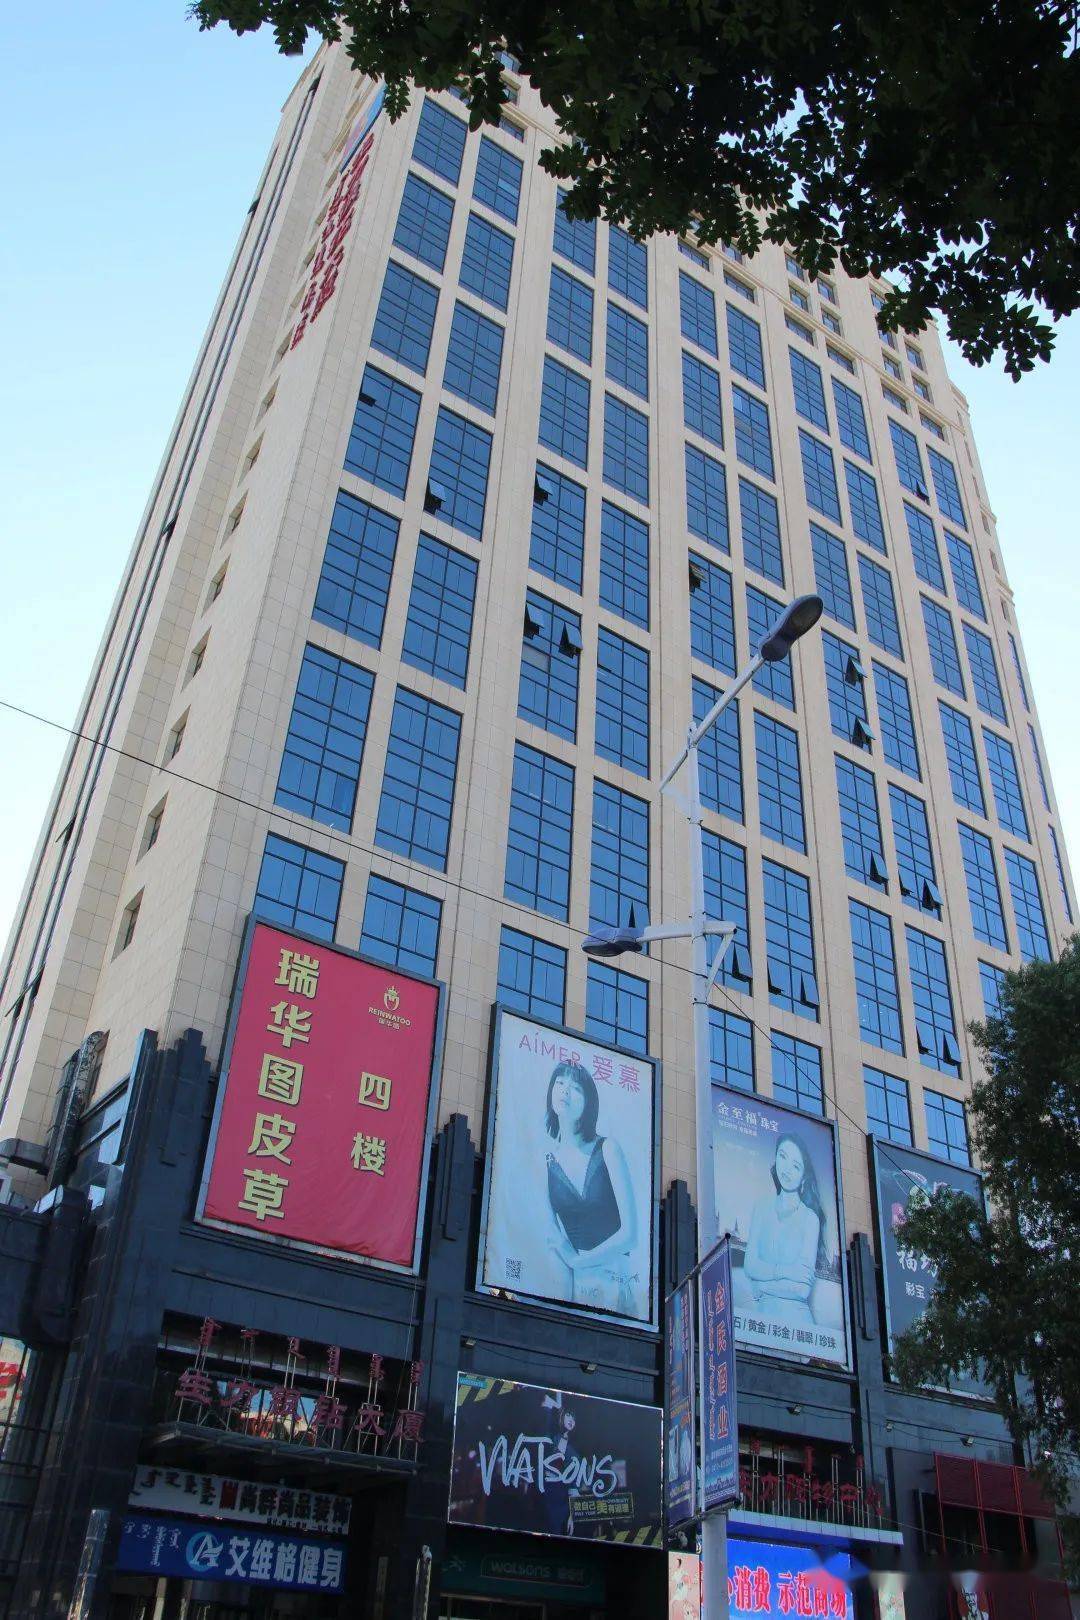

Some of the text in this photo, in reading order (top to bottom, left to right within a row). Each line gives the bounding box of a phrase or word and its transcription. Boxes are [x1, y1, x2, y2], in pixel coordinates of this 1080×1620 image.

[238, 948, 320, 1221] 瑞华图皮草
[592, 1054, 641, 1093] 爱慕
[351, 1071, 392, 1177] 四楼
[224, 1536, 343, 1588] 艾维格健身
[728, 1566, 771, 1614] 消费
